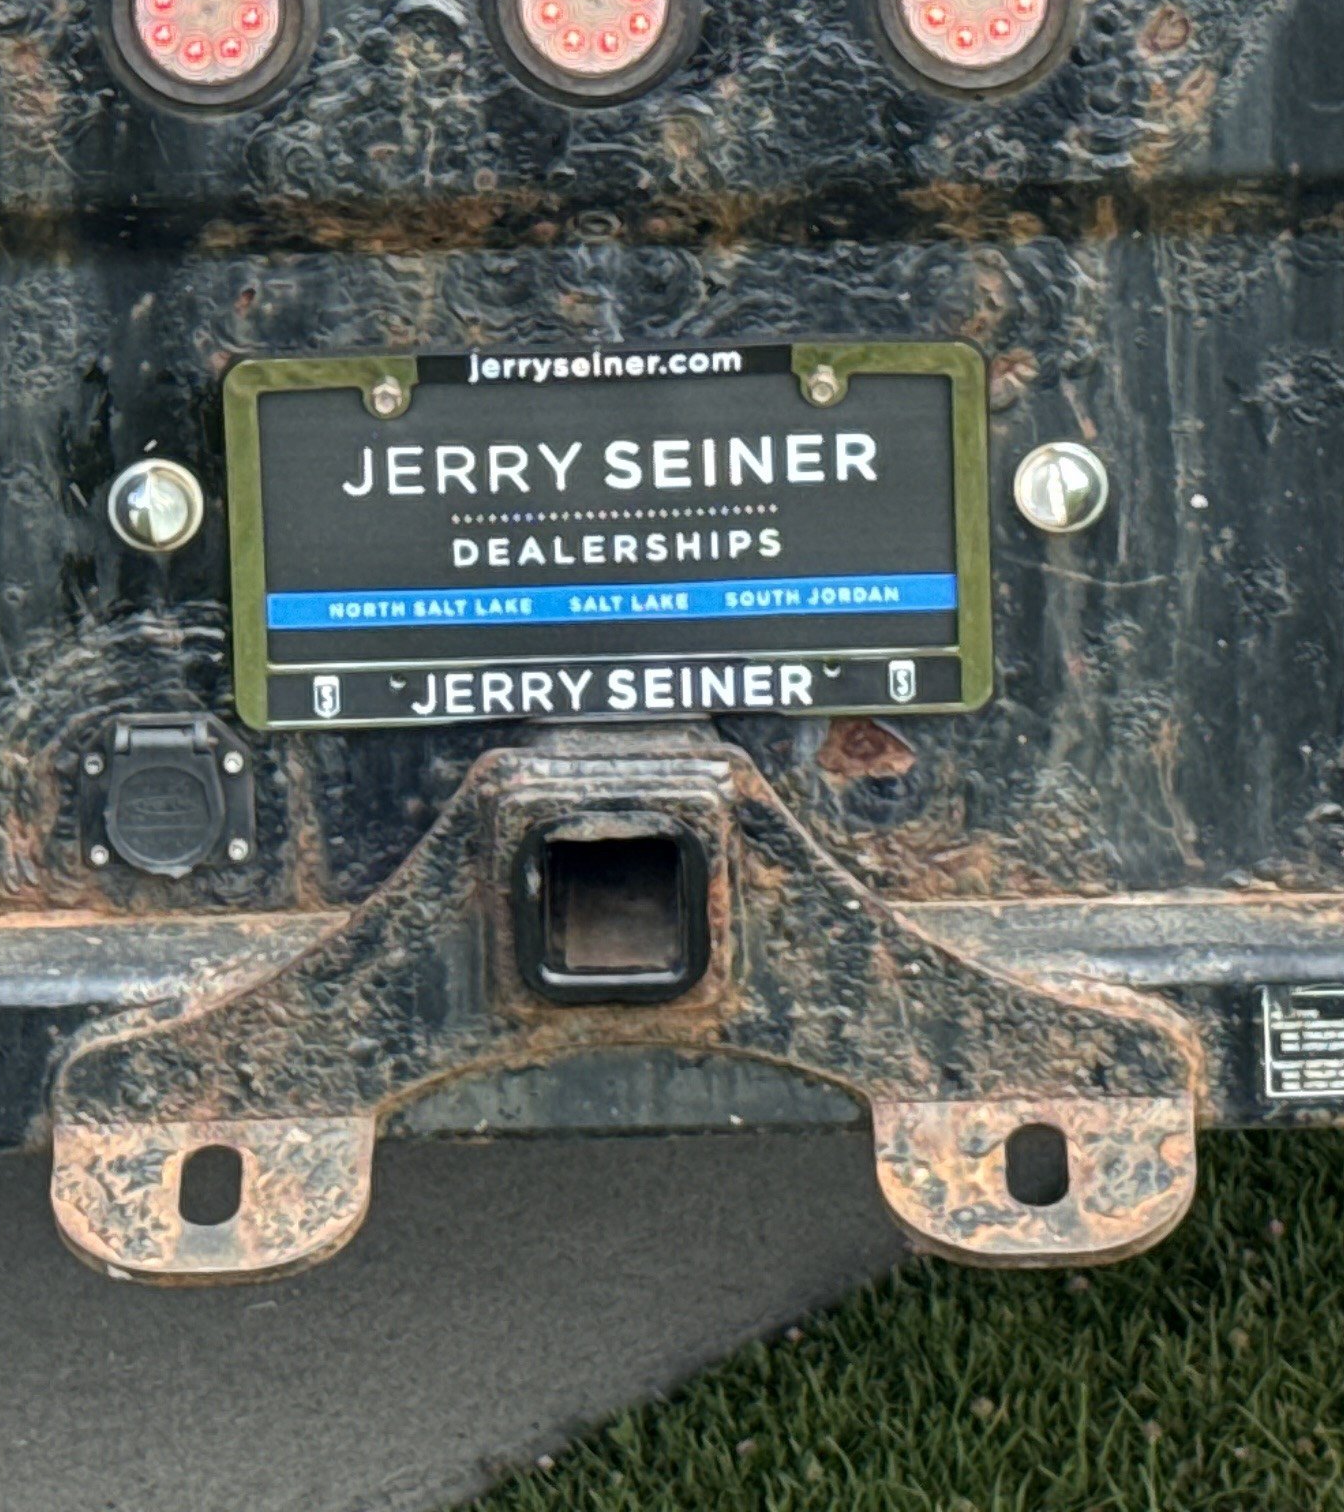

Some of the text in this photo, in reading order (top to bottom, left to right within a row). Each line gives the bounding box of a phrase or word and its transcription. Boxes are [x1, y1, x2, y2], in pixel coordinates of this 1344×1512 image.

[467, 345, 743, 384] jerryseiner.com
[340, 432, 878, 497] JERRY SEINER
[451, 527, 783, 569] DEALERSHIPS
[328, 597, 534, 619] NORTH SALT LAKE
[568, 592, 689, 614] SALT LAKE
[724, 585, 900, 608] SOUTH JORDAN
[410, 664, 815, 717] JERRY SEINER
